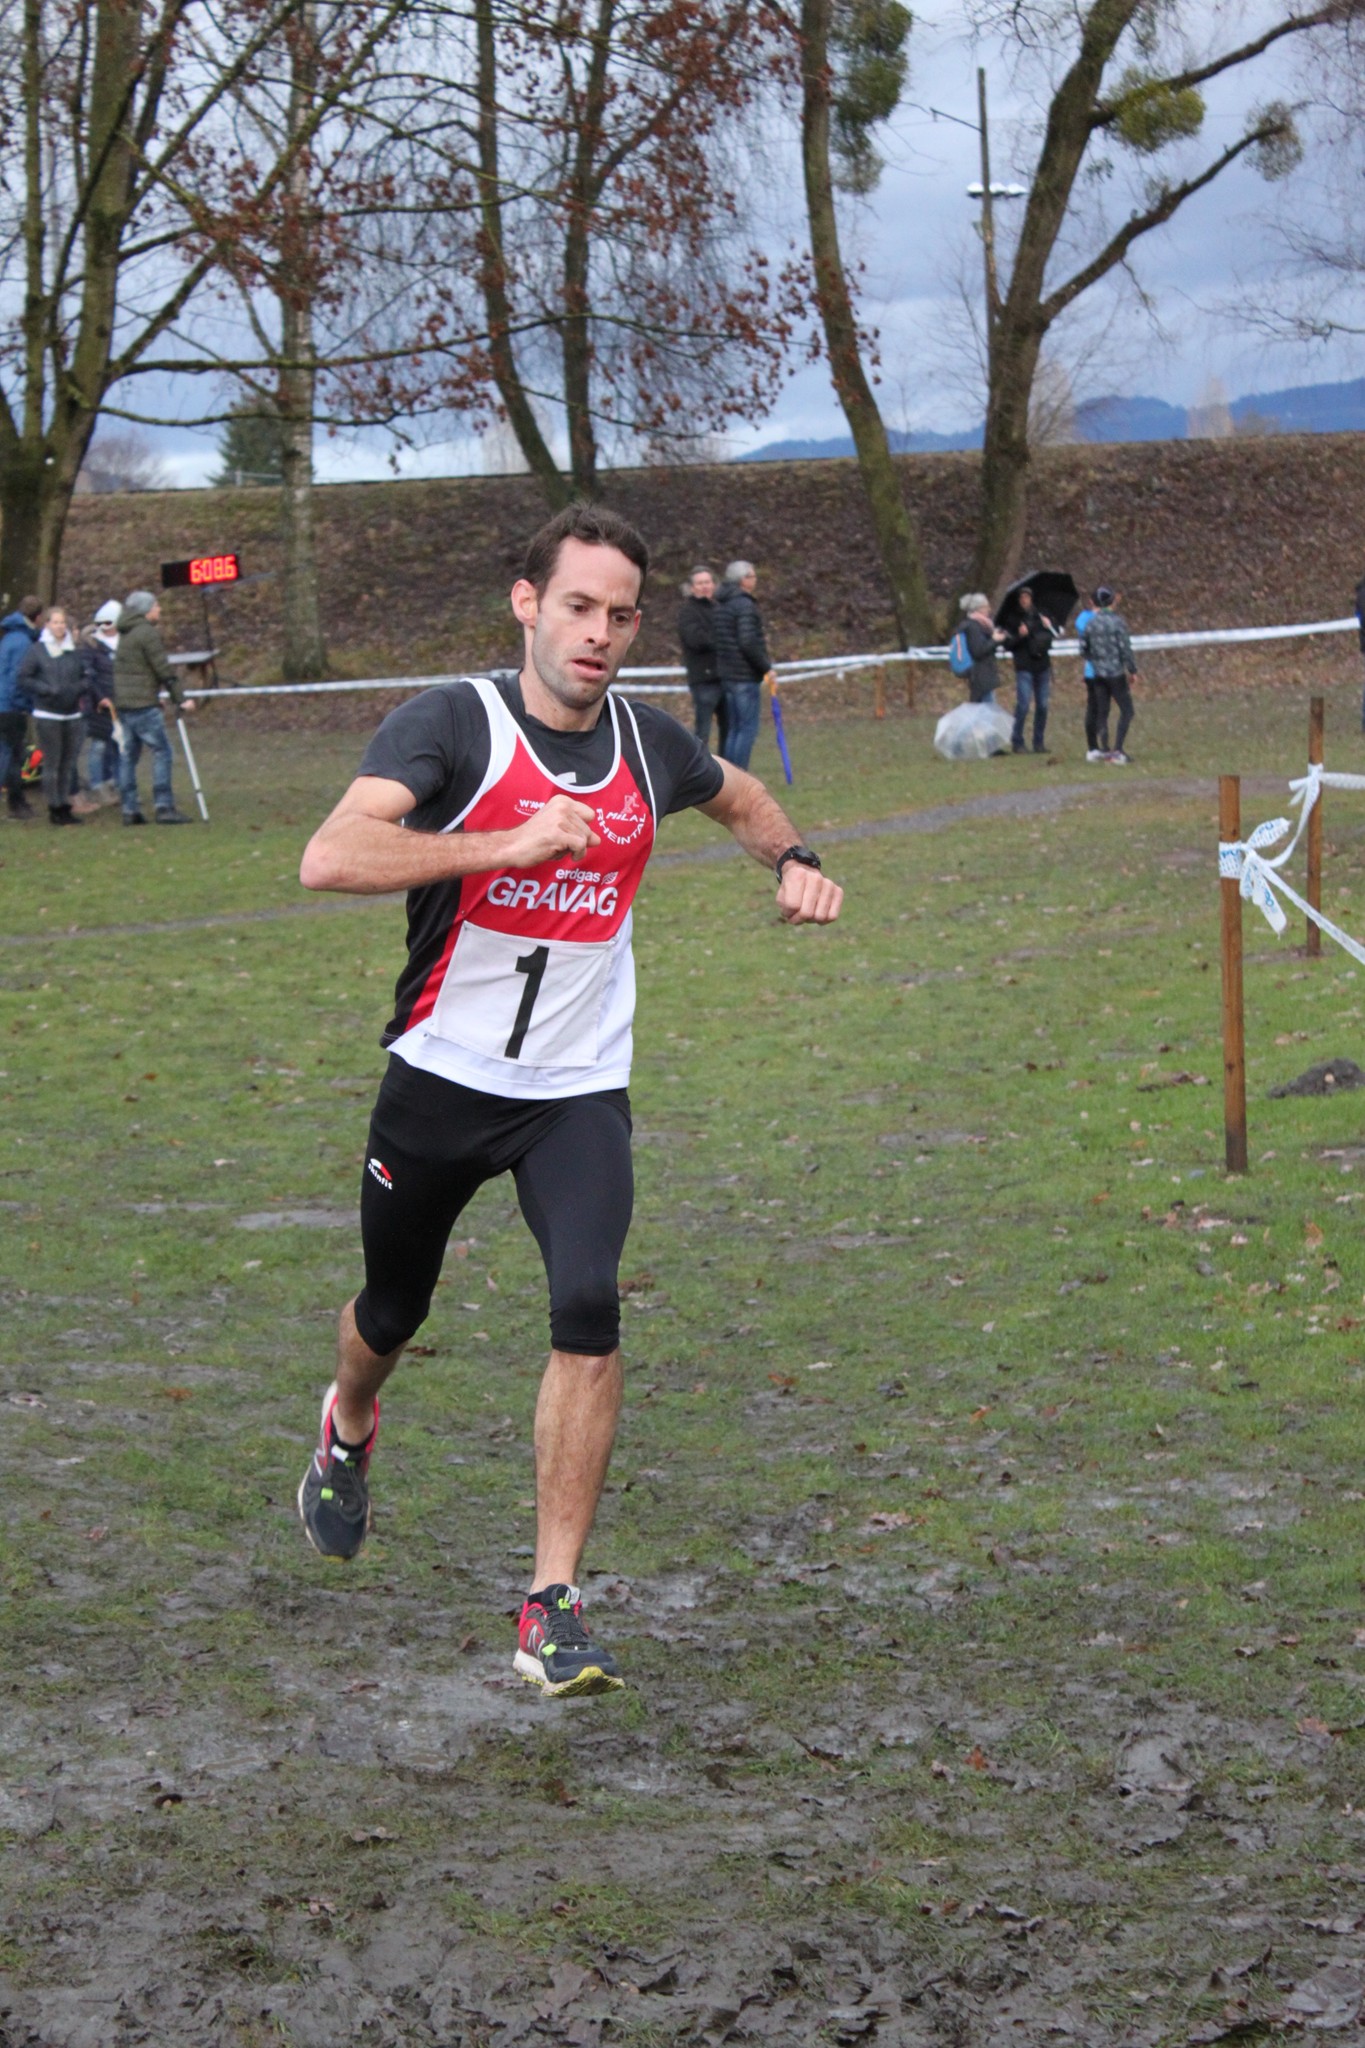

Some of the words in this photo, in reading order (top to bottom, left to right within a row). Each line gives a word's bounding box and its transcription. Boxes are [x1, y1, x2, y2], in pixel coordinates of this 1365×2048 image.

[596, 807, 646, 846] RHEINTAL
[555, 868, 601, 883] erdgas
[486, 876, 618, 917] GRAVAG
[504, 945, 550, 1060] 1
